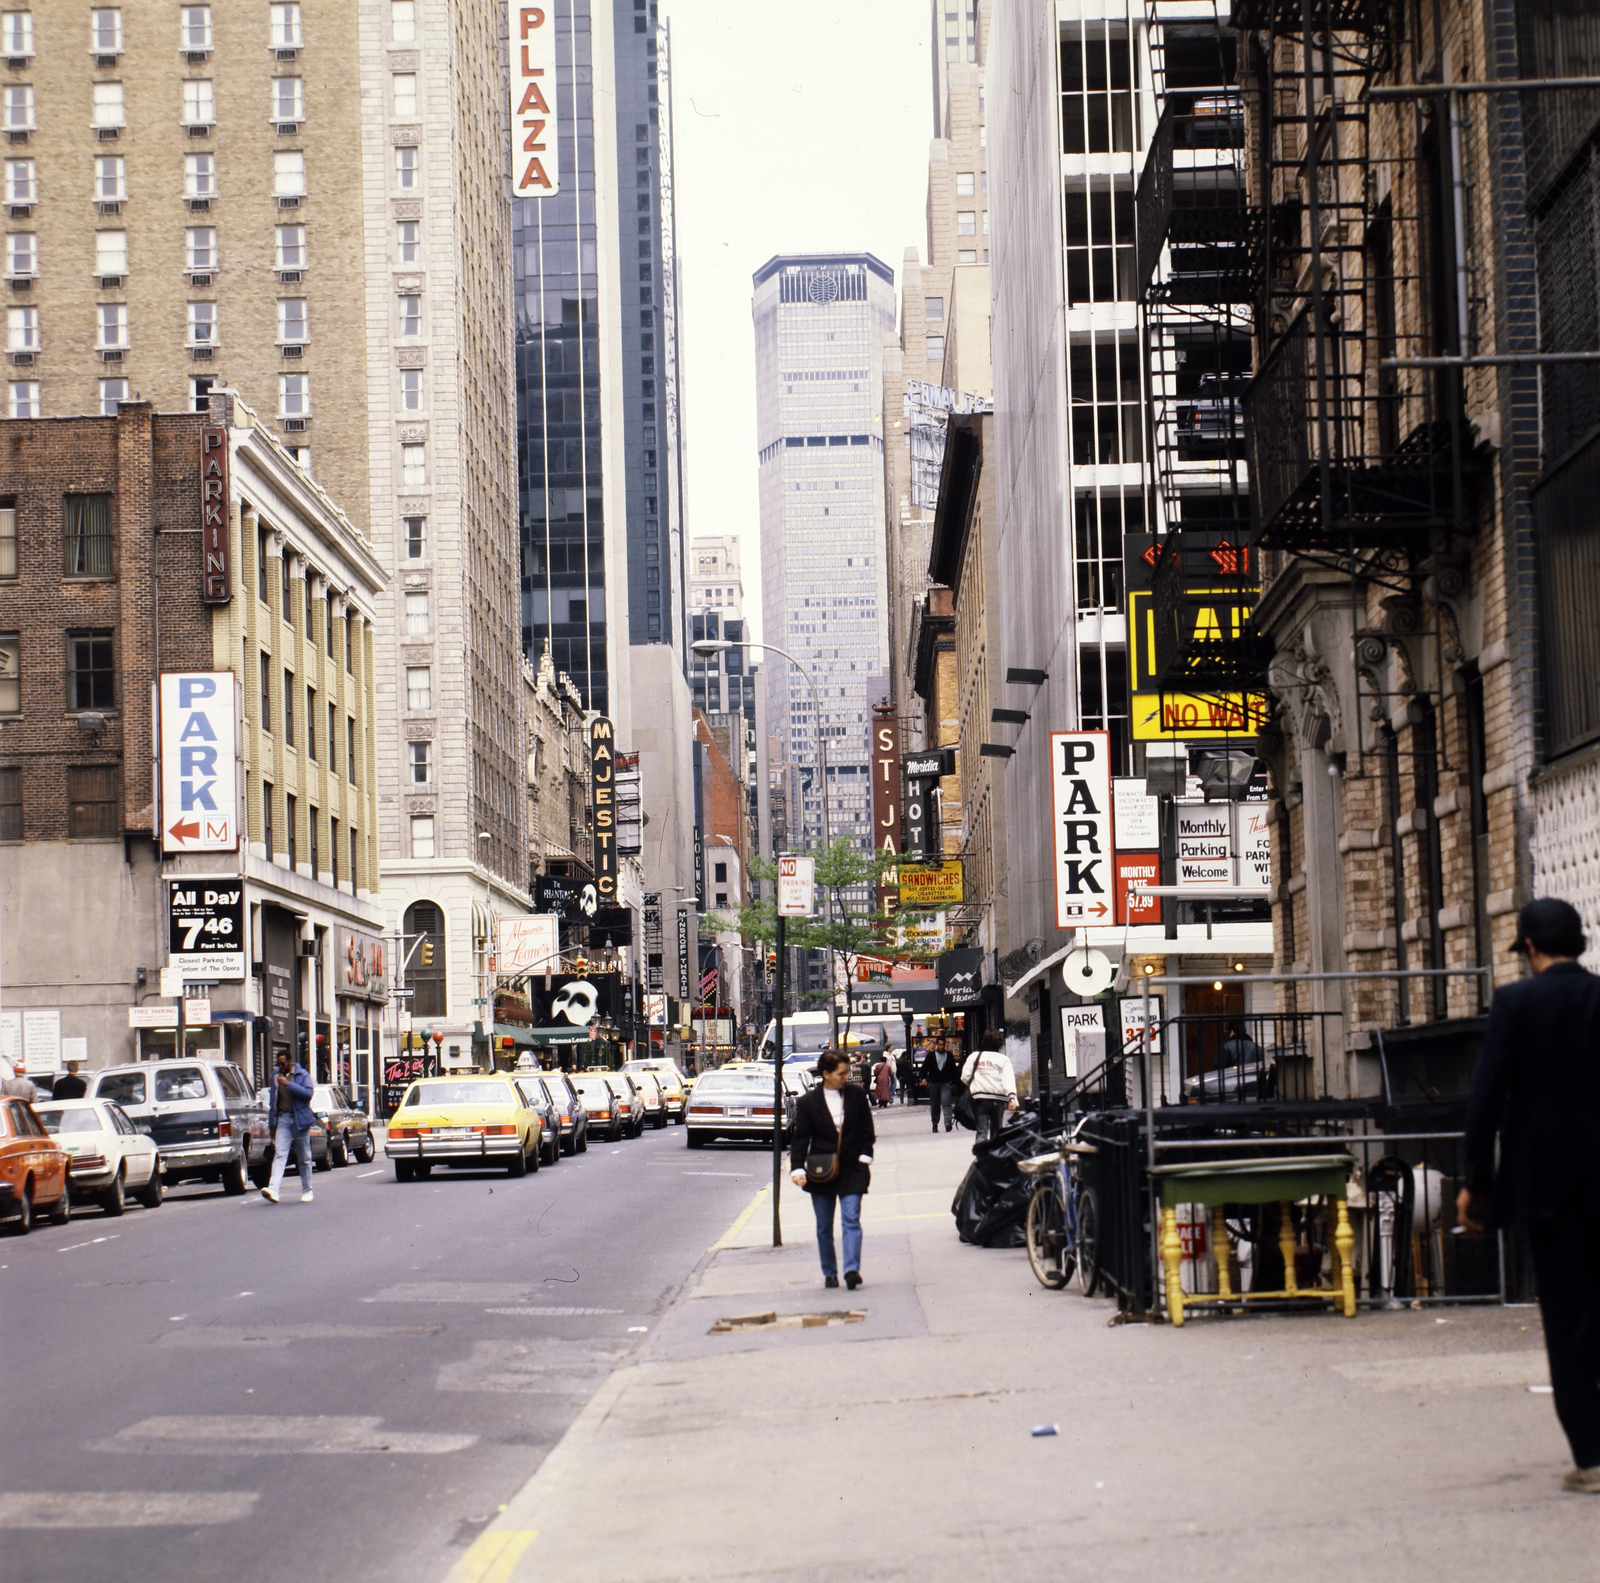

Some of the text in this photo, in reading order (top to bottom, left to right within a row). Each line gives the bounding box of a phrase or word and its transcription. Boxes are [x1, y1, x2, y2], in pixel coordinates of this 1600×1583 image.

[517, 7, 553, 190] PLAZA
[204, 432, 226, 598] PARKING
[1165, 701, 1265, 728] NO WAT
[178, 677, 218, 812] PARK
[906, 760, 939, 775] Meridia
[1249, 785, 1265, 793] Enter
[593, 722, 614, 893] MAJESTIC
[1061, 740, 1105, 895] PARK
[1180, 820, 1226, 836] Monthly
[1181, 843, 1227, 858] Parking
[1257, 839, 1270, 848] FO
[694, 829, 702, 895] LOEWS
[781, 861, 796, 875] NO
[881, 804, 898, 948] JAMES
[901, 872, 960, 886] SANDWICHES
[1120, 866, 1156, 878] MONTHLY
[1182, 865, 1228, 878] Welcome
[172, 890, 241, 906] All Day
[543, 889, 571, 900] PHANTOM
[506, 921, 544, 947] Mamma
[504, 938, 550, 968] Leone's
[678, 911, 688, 998] MINSKOFF THEATRE
[842, 998, 914, 1014] HOTEL
[1125, 1001, 1153, 1015] Specil
[1067, 1013, 1099, 1027] PARK
[1125, 1015, 1158, 1024] 1/2 HUR
